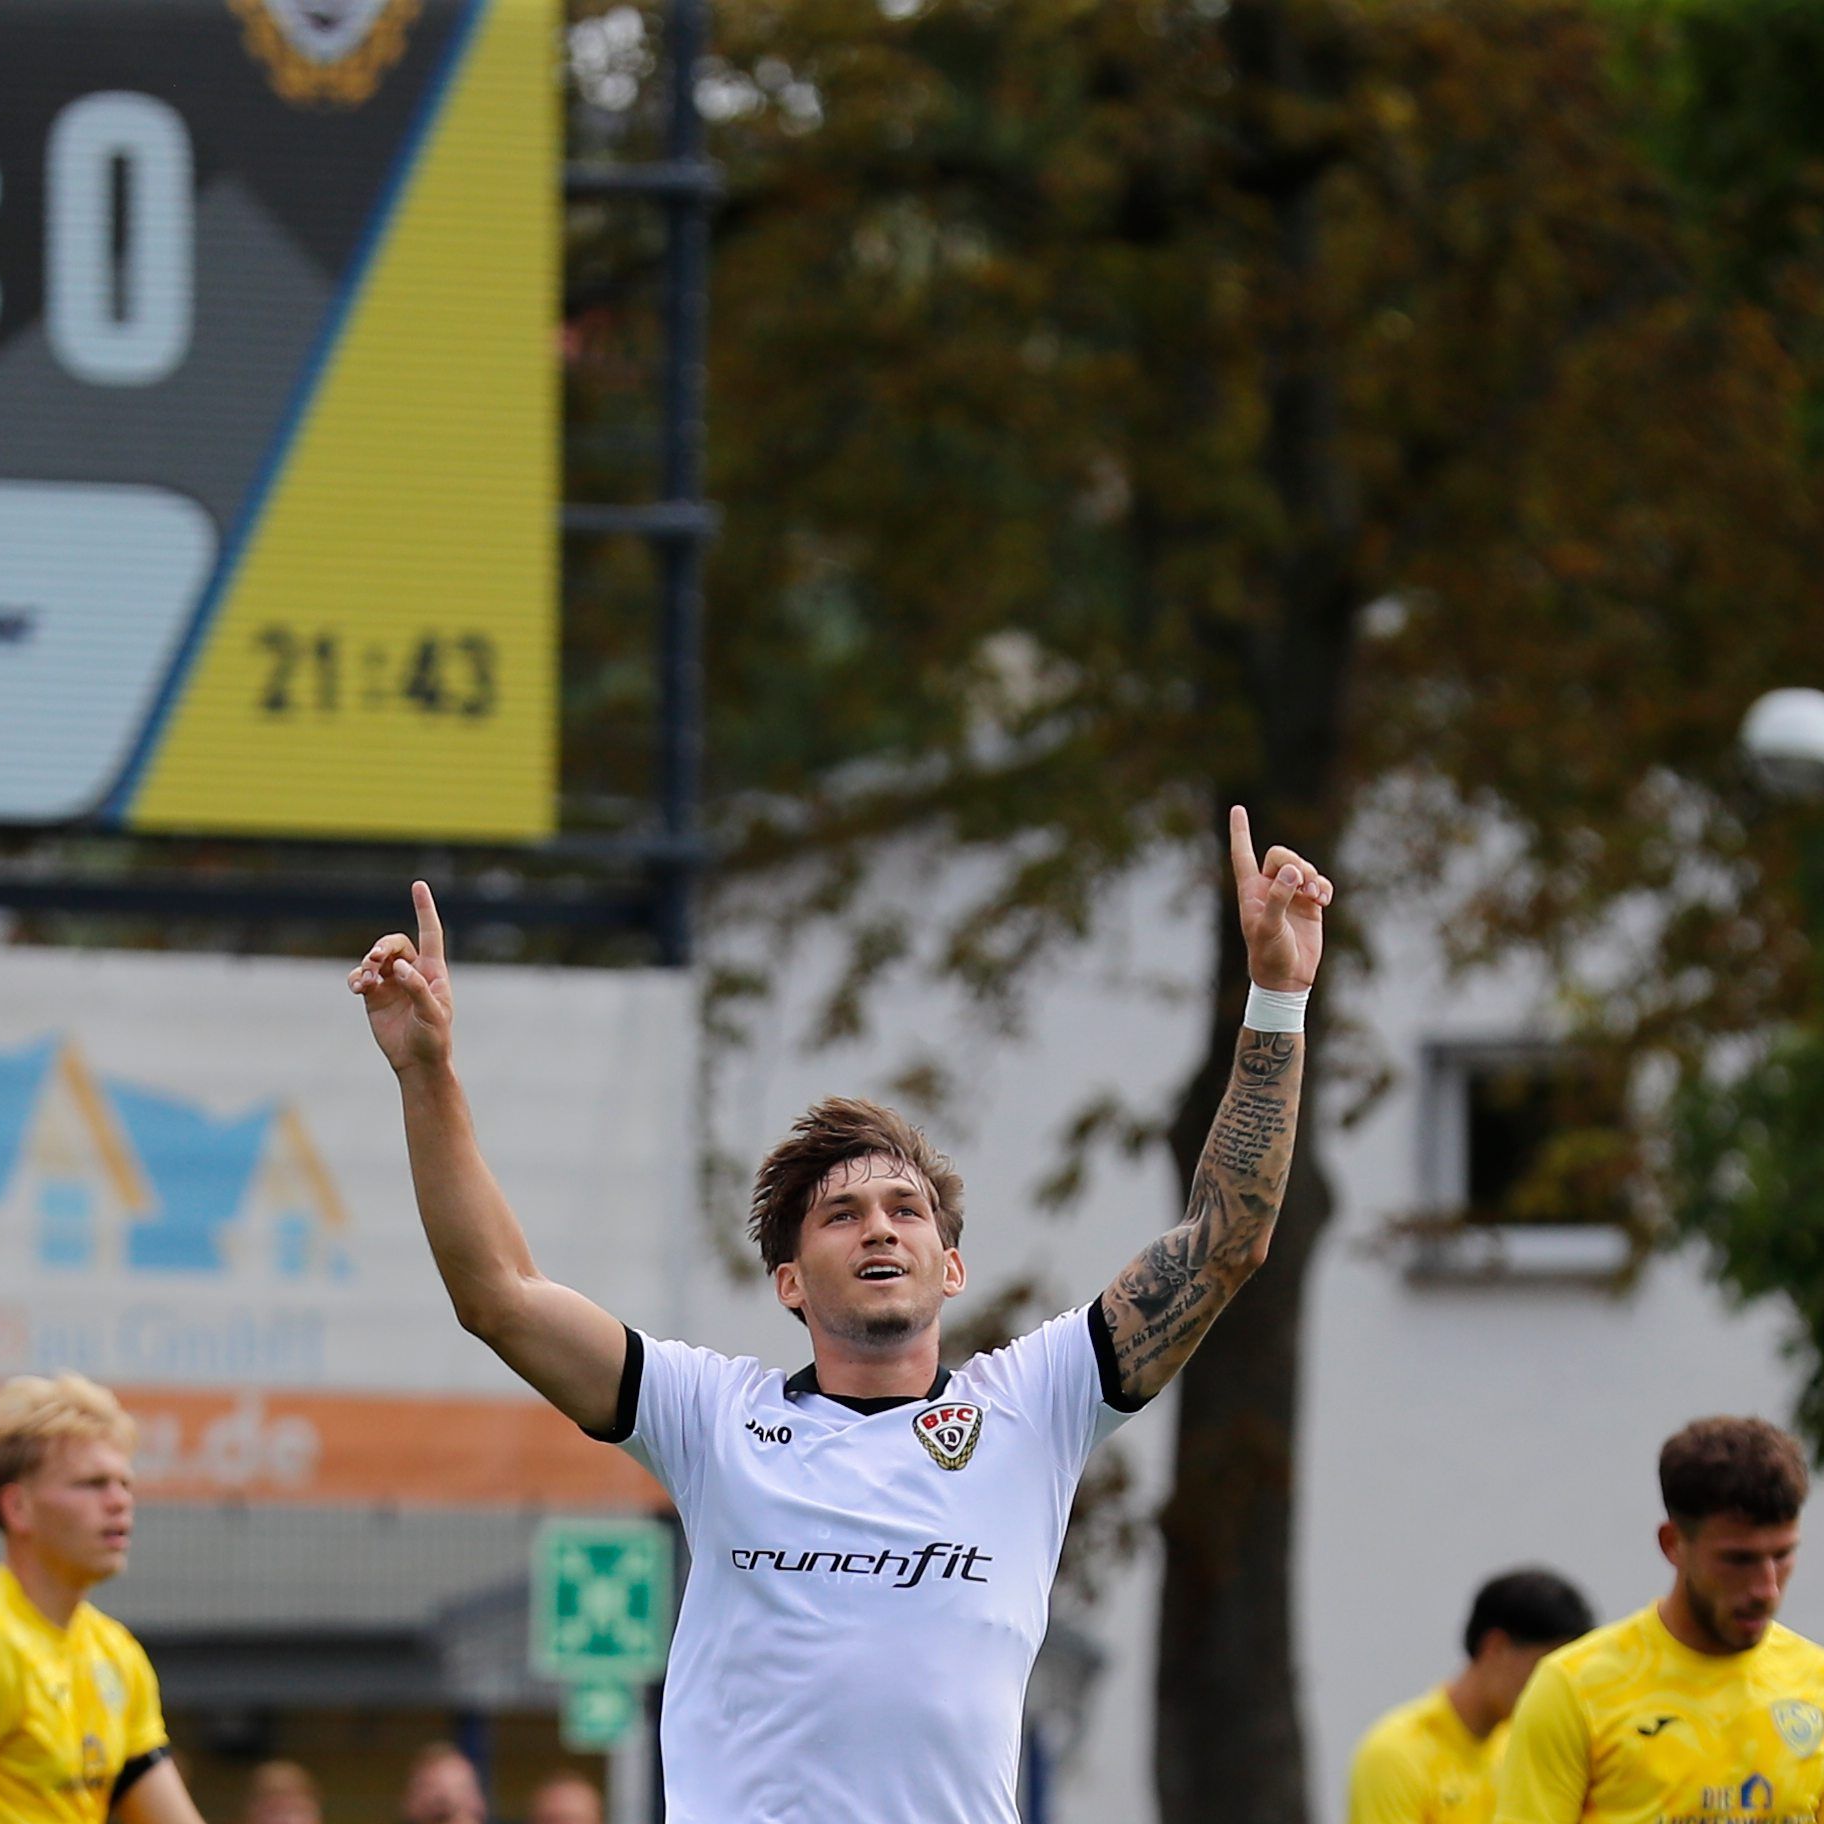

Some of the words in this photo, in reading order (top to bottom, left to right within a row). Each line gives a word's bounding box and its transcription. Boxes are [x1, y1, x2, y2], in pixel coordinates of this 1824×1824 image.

[256, 628, 498, 722] 21:43
[744, 1418, 793, 1446] JAKO
[921, 1407, 974, 1430] BFC
[731, 1542, 994, 1589] crunchfit
